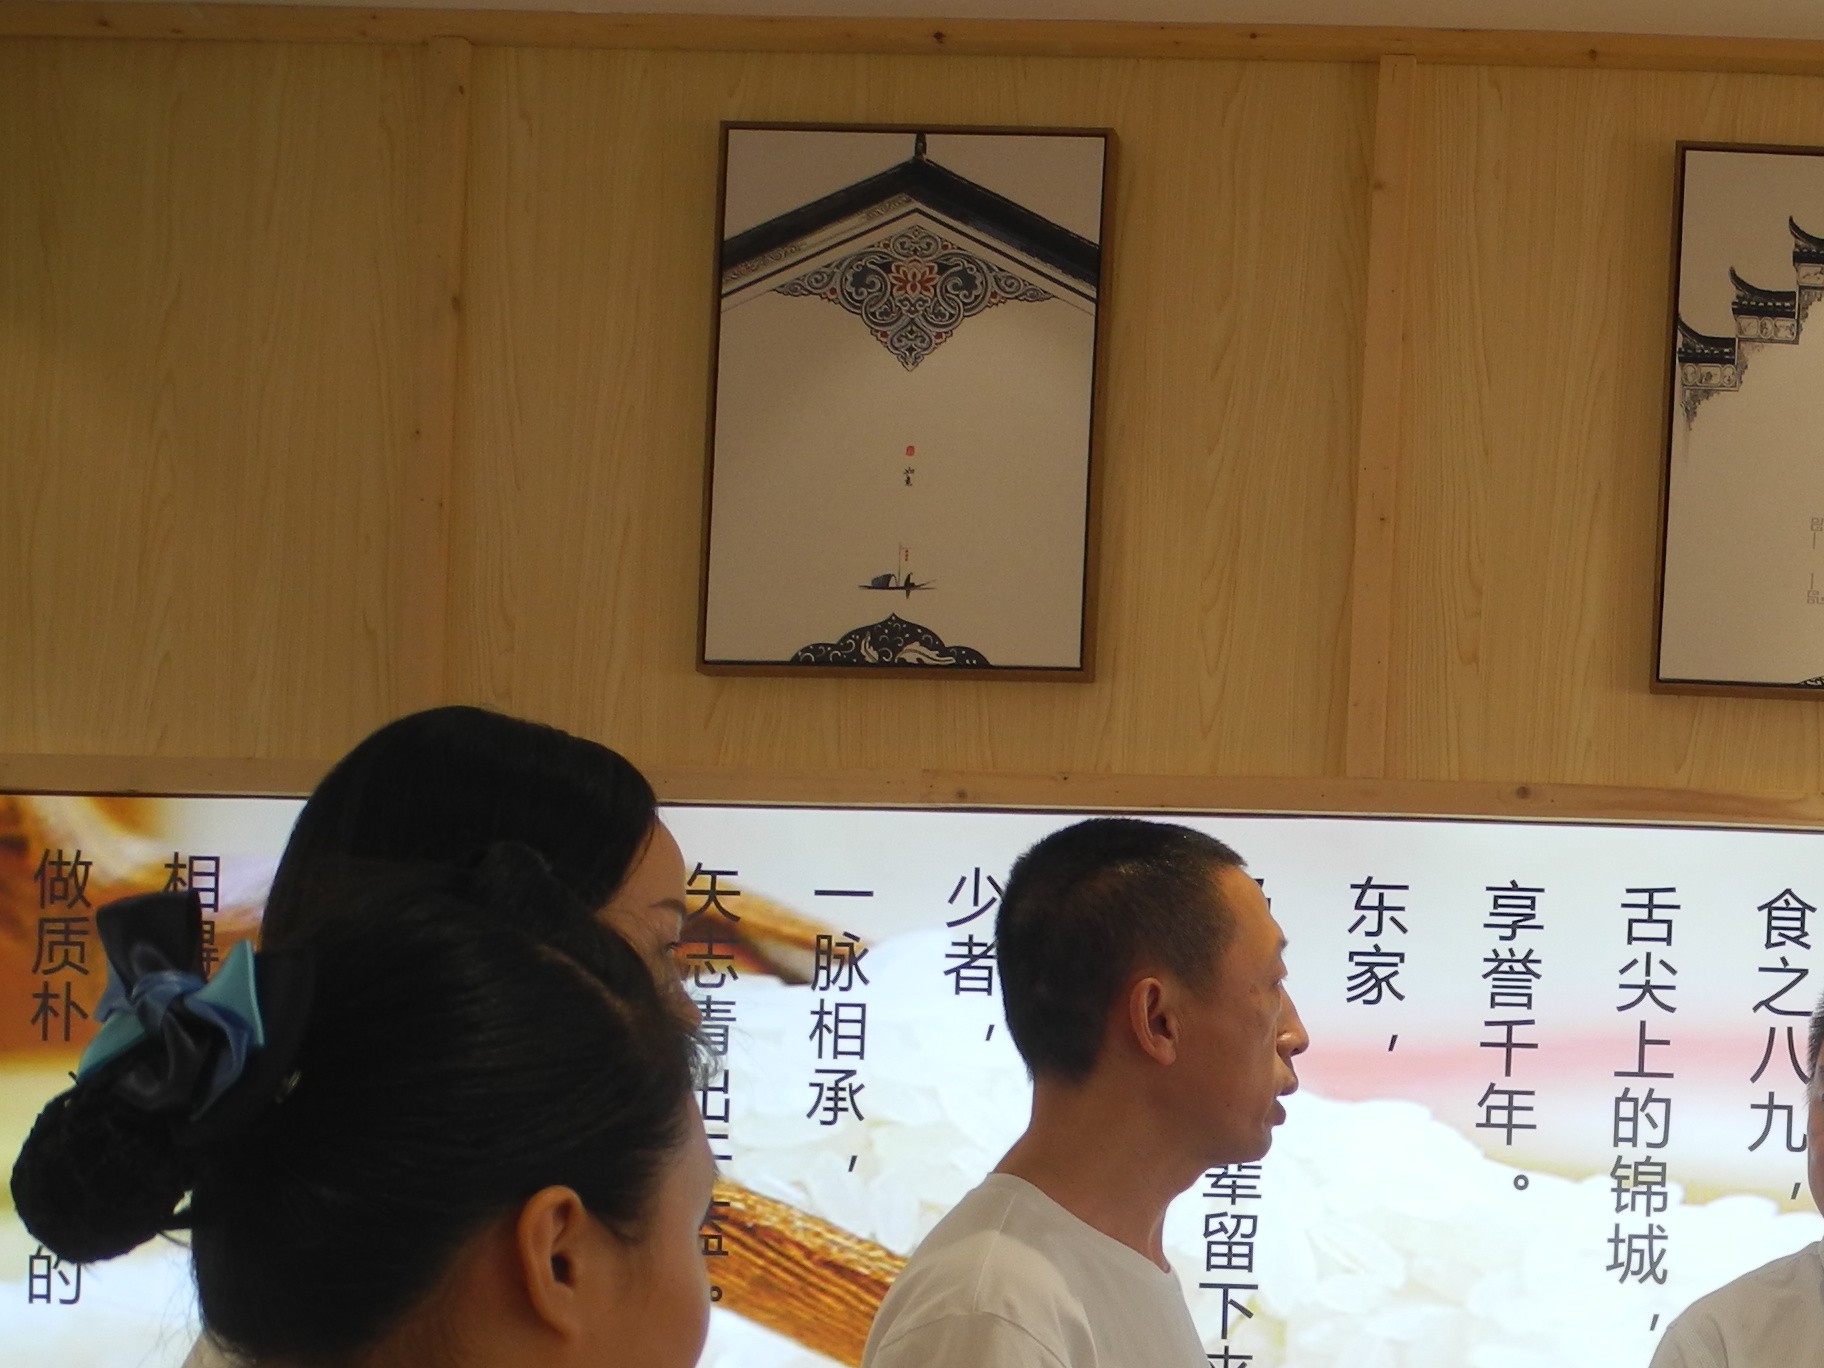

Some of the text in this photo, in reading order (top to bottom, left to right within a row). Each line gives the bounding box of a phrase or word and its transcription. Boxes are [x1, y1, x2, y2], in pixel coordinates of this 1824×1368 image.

[805, 891, 874, 1174] 一脉相承，
[1345, 875, 1410, 1054] 东家，
[1475, 879, 1545, 1193] 享誉千年。
[1605, 886, 1681, 1333] 舌尖上的锦城，
[1747, 888, 1818, 1201] 食之八九，
